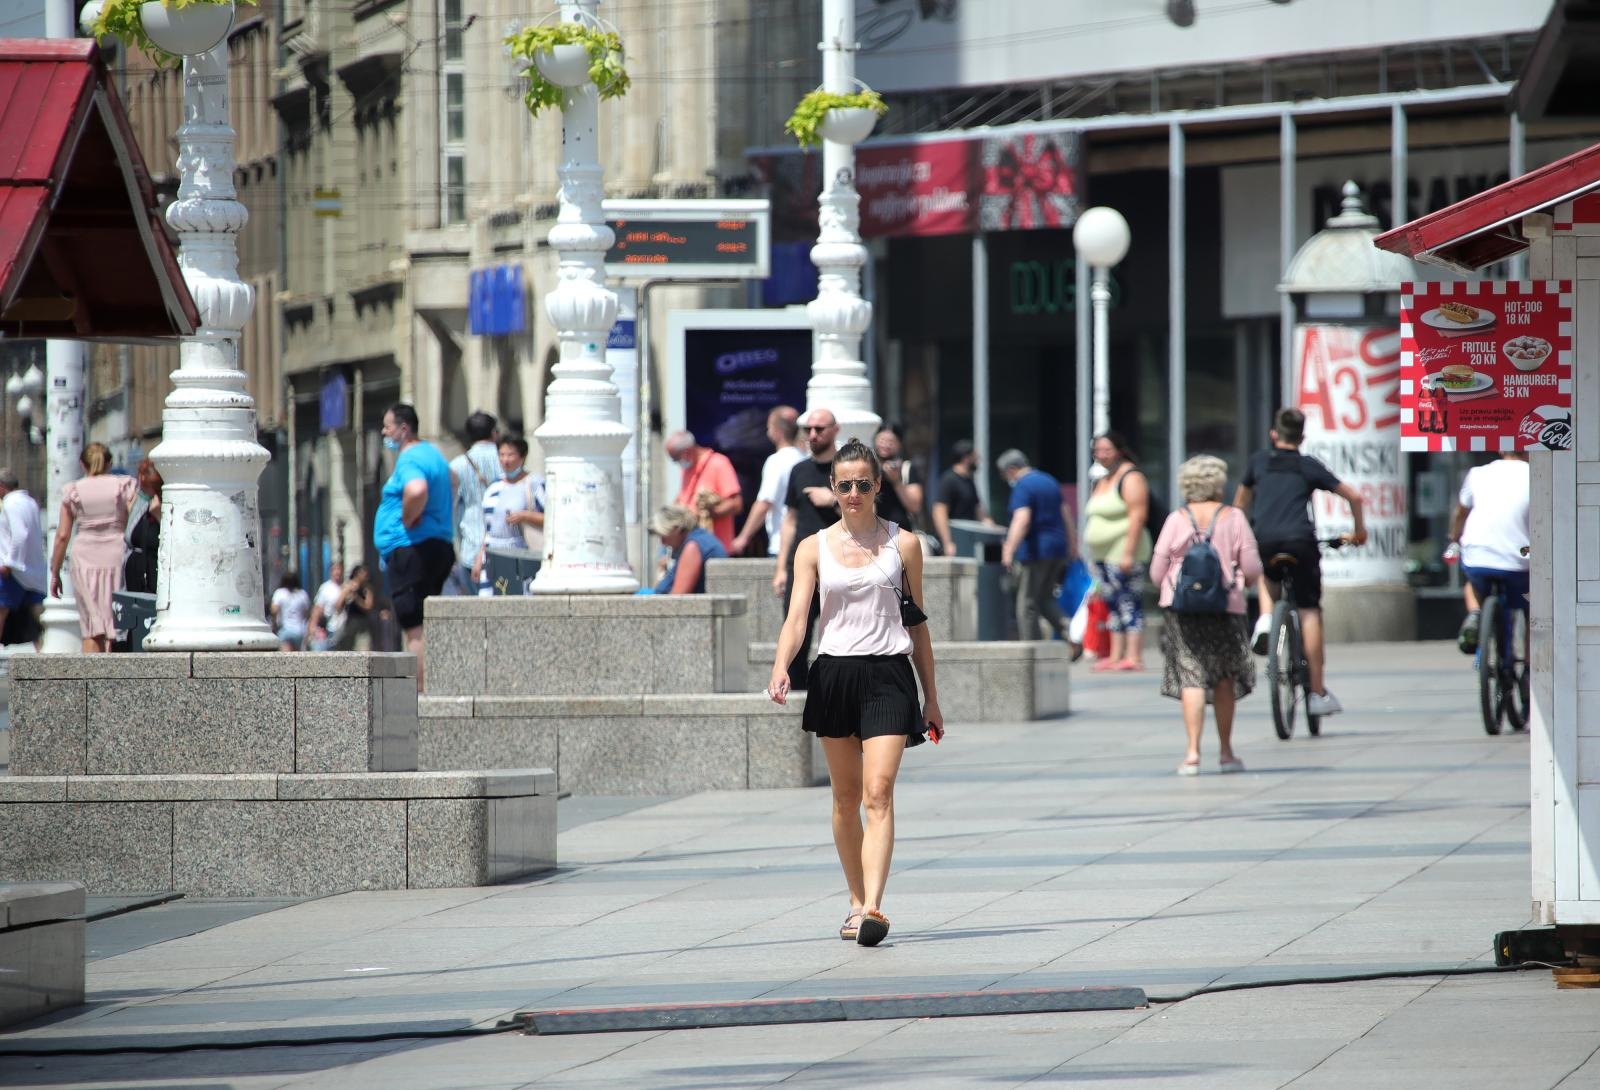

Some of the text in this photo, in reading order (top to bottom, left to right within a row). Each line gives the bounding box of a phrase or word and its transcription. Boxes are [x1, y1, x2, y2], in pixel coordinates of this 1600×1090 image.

[1504, 301, 1542, 313] HOT-DOG
[1506, 314, 1530, 325] 18 KN
[1461, 341, 1497, 353] FRITULE
[1470, 353, 1497, 365] 20 KN
[1503, 374, 1557, 386] HAMBURGER
[1503, 386, 1529, 398] 35 KN
